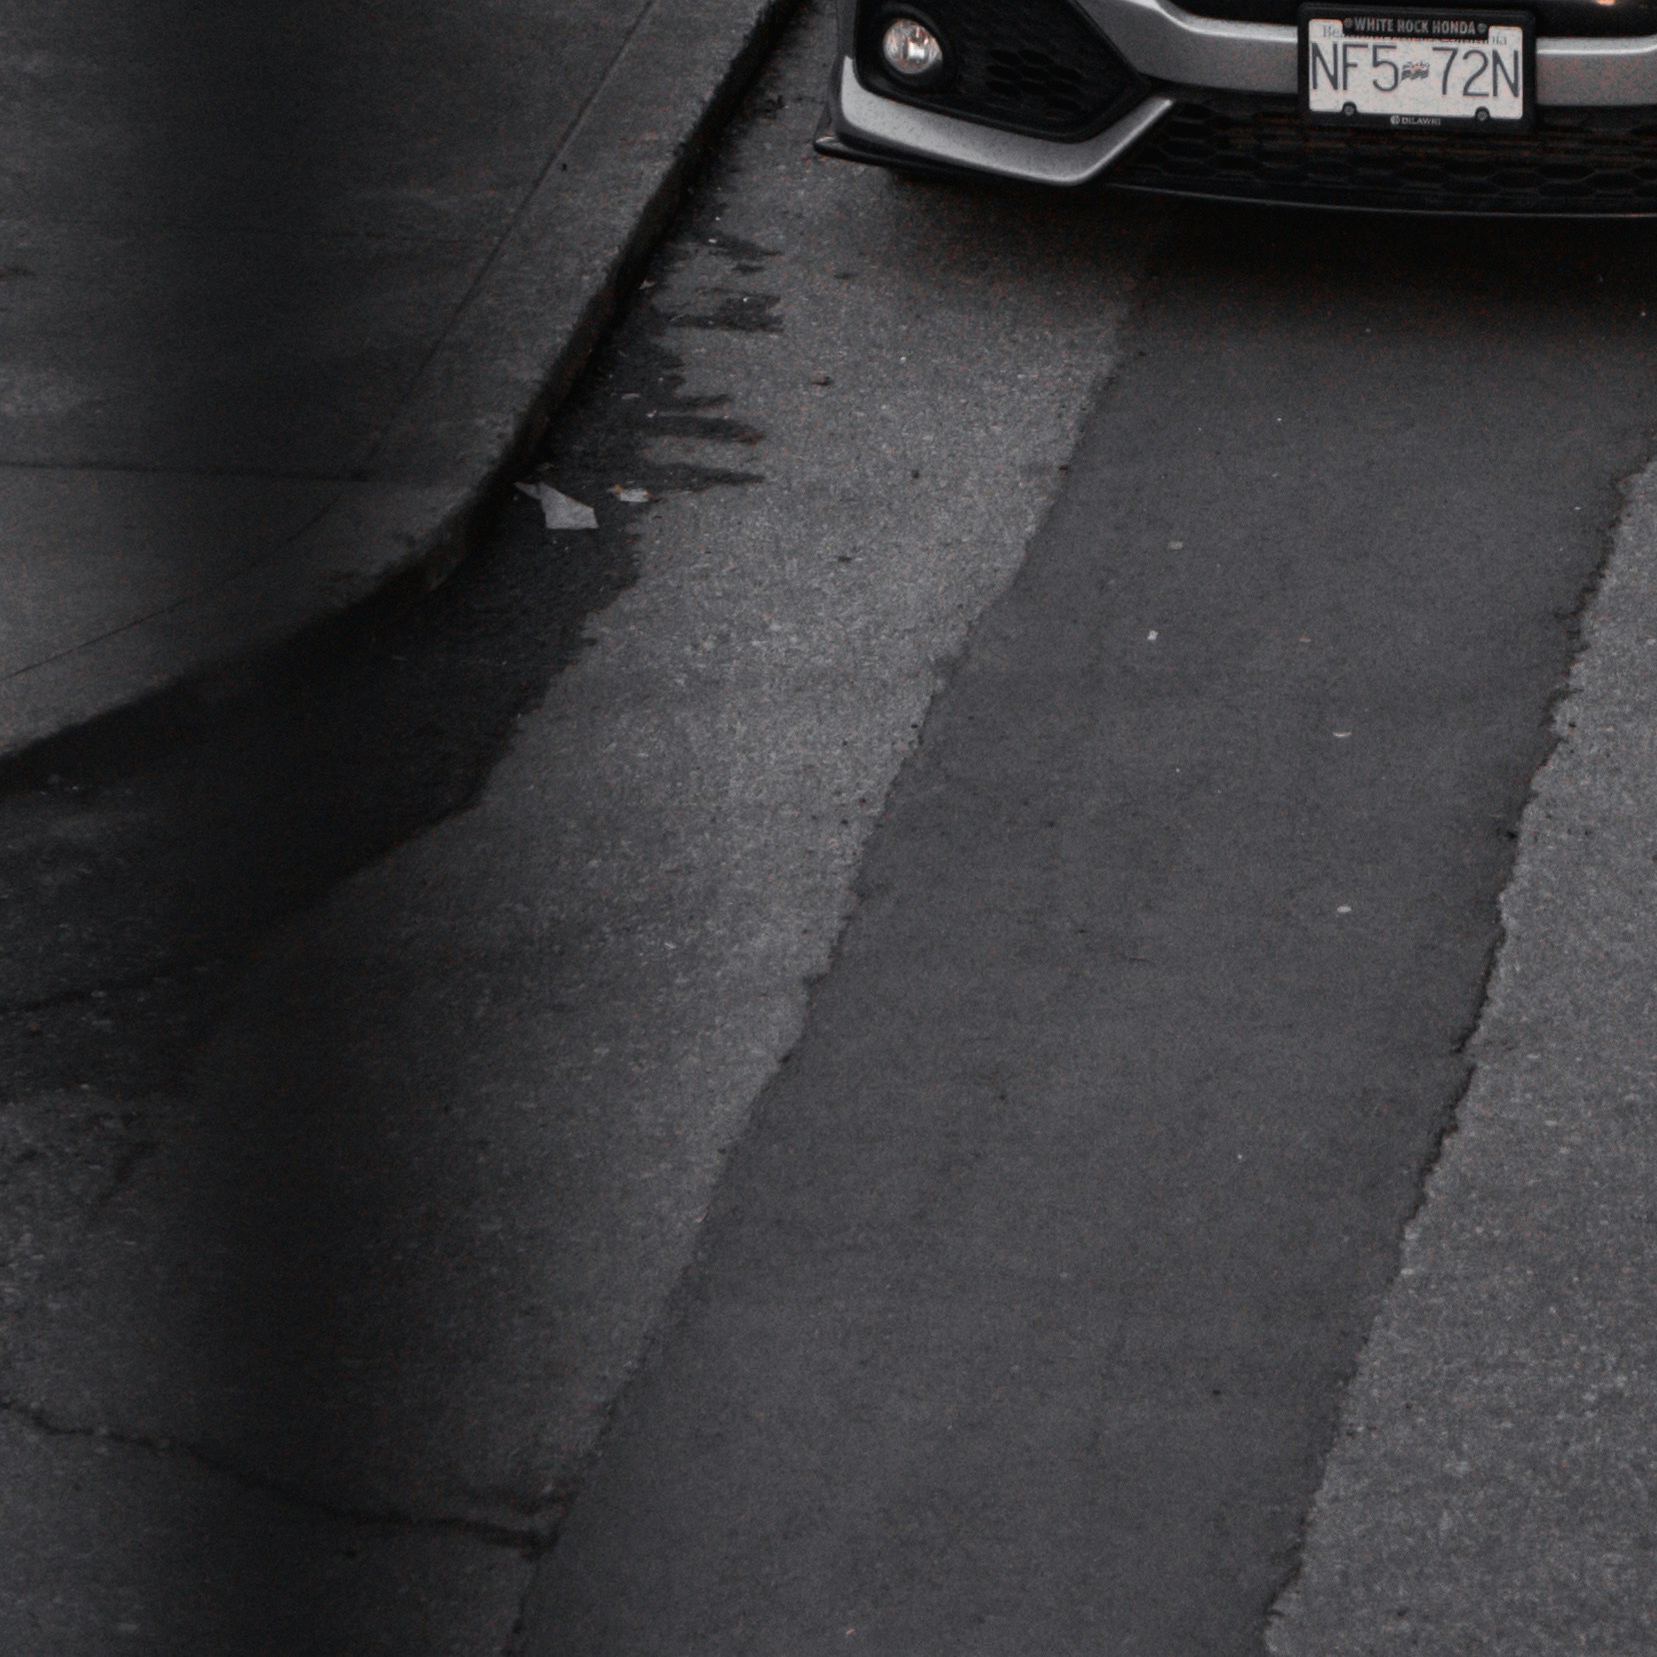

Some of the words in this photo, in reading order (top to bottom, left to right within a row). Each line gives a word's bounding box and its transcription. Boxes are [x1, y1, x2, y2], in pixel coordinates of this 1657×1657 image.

[1354, 17, 1394, 34] WHITE
[1397, 18, 1429, 34] ROCK
[1431, 20, 1476, 36] HONDA
[1311, 42, 1399, 92] NF5
[1432, 47, 1519, 98] 72N
